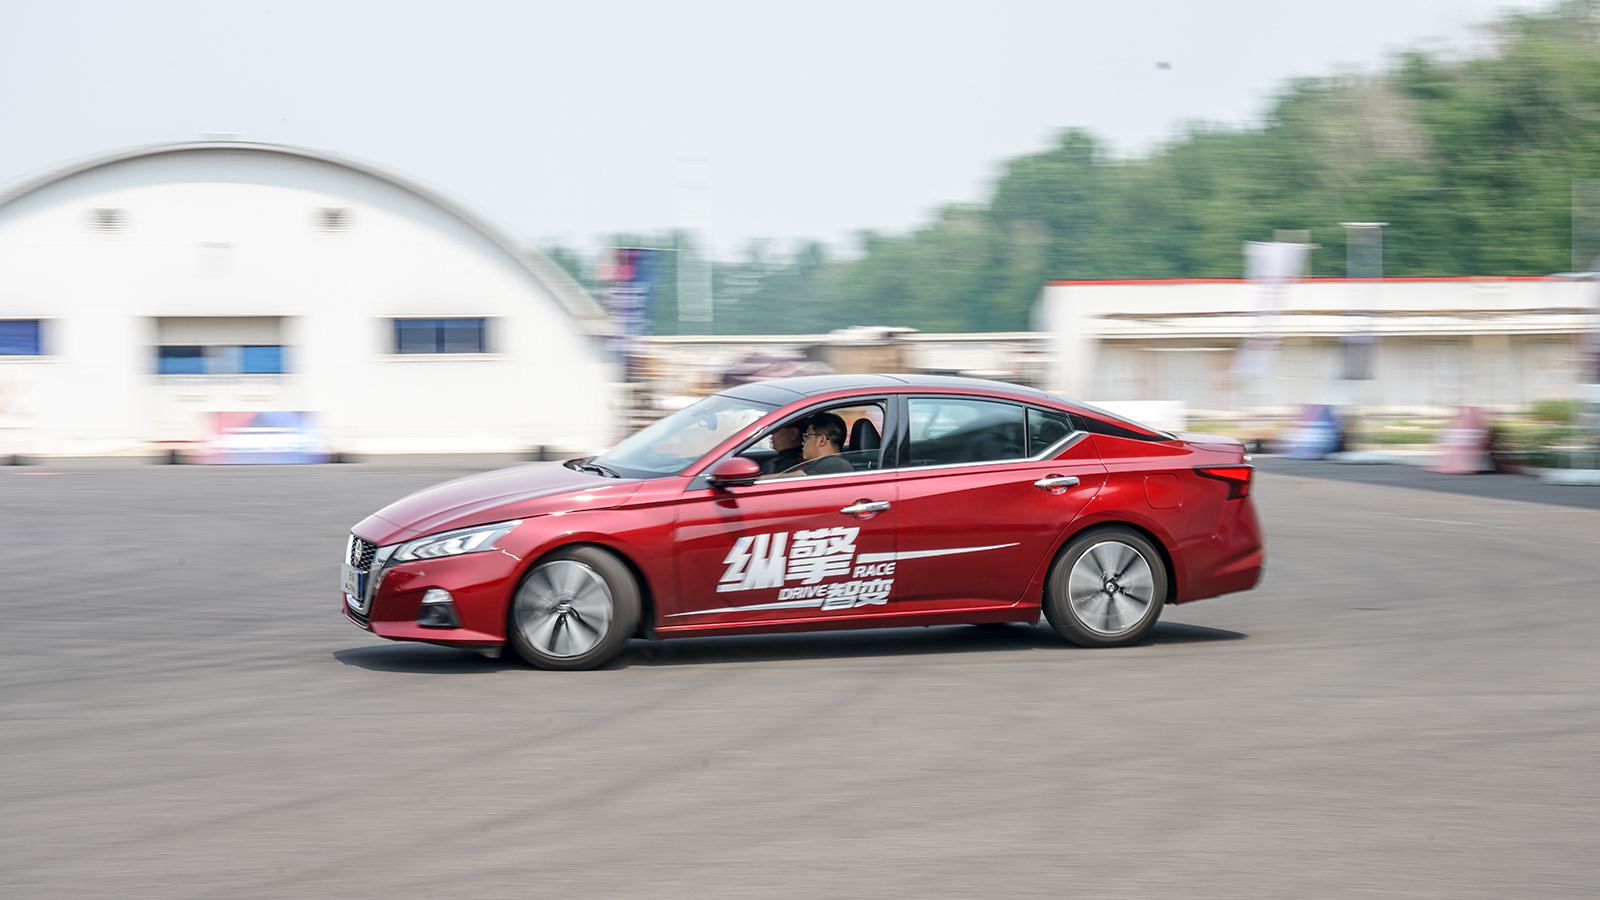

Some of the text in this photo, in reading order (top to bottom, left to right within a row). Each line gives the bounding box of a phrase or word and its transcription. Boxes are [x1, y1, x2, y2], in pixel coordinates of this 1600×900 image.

[716, 526, 860, 593] 纵擎
[852, 562, 896, 579] RACE
[778, 584, 828, 600] DRIVE
[821, 578, 894, 611] 智变
